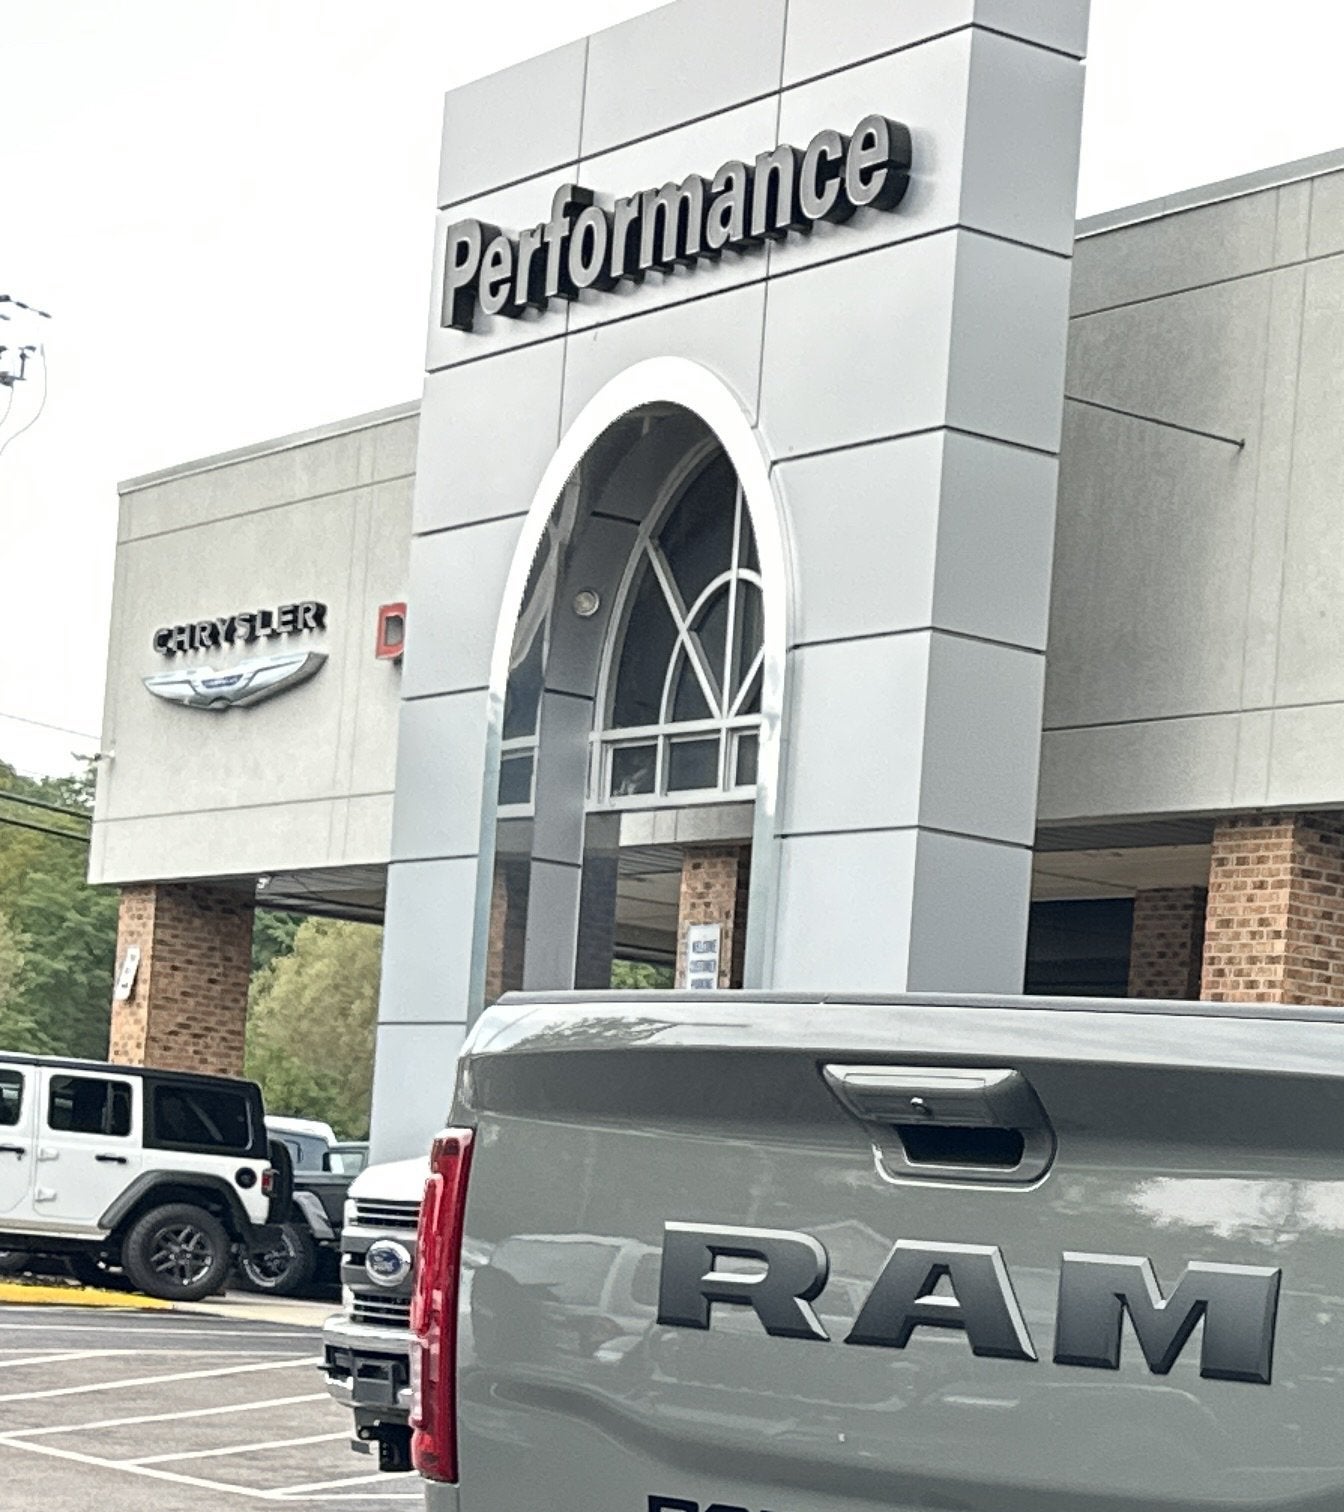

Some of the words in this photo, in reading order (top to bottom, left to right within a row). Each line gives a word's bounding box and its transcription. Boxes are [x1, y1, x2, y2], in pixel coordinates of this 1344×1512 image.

[441, 114, 912, 331] Performance
[153, 600, 328, 656] CHRYSLER
[657, 1221, 1282, 1386] RAM
